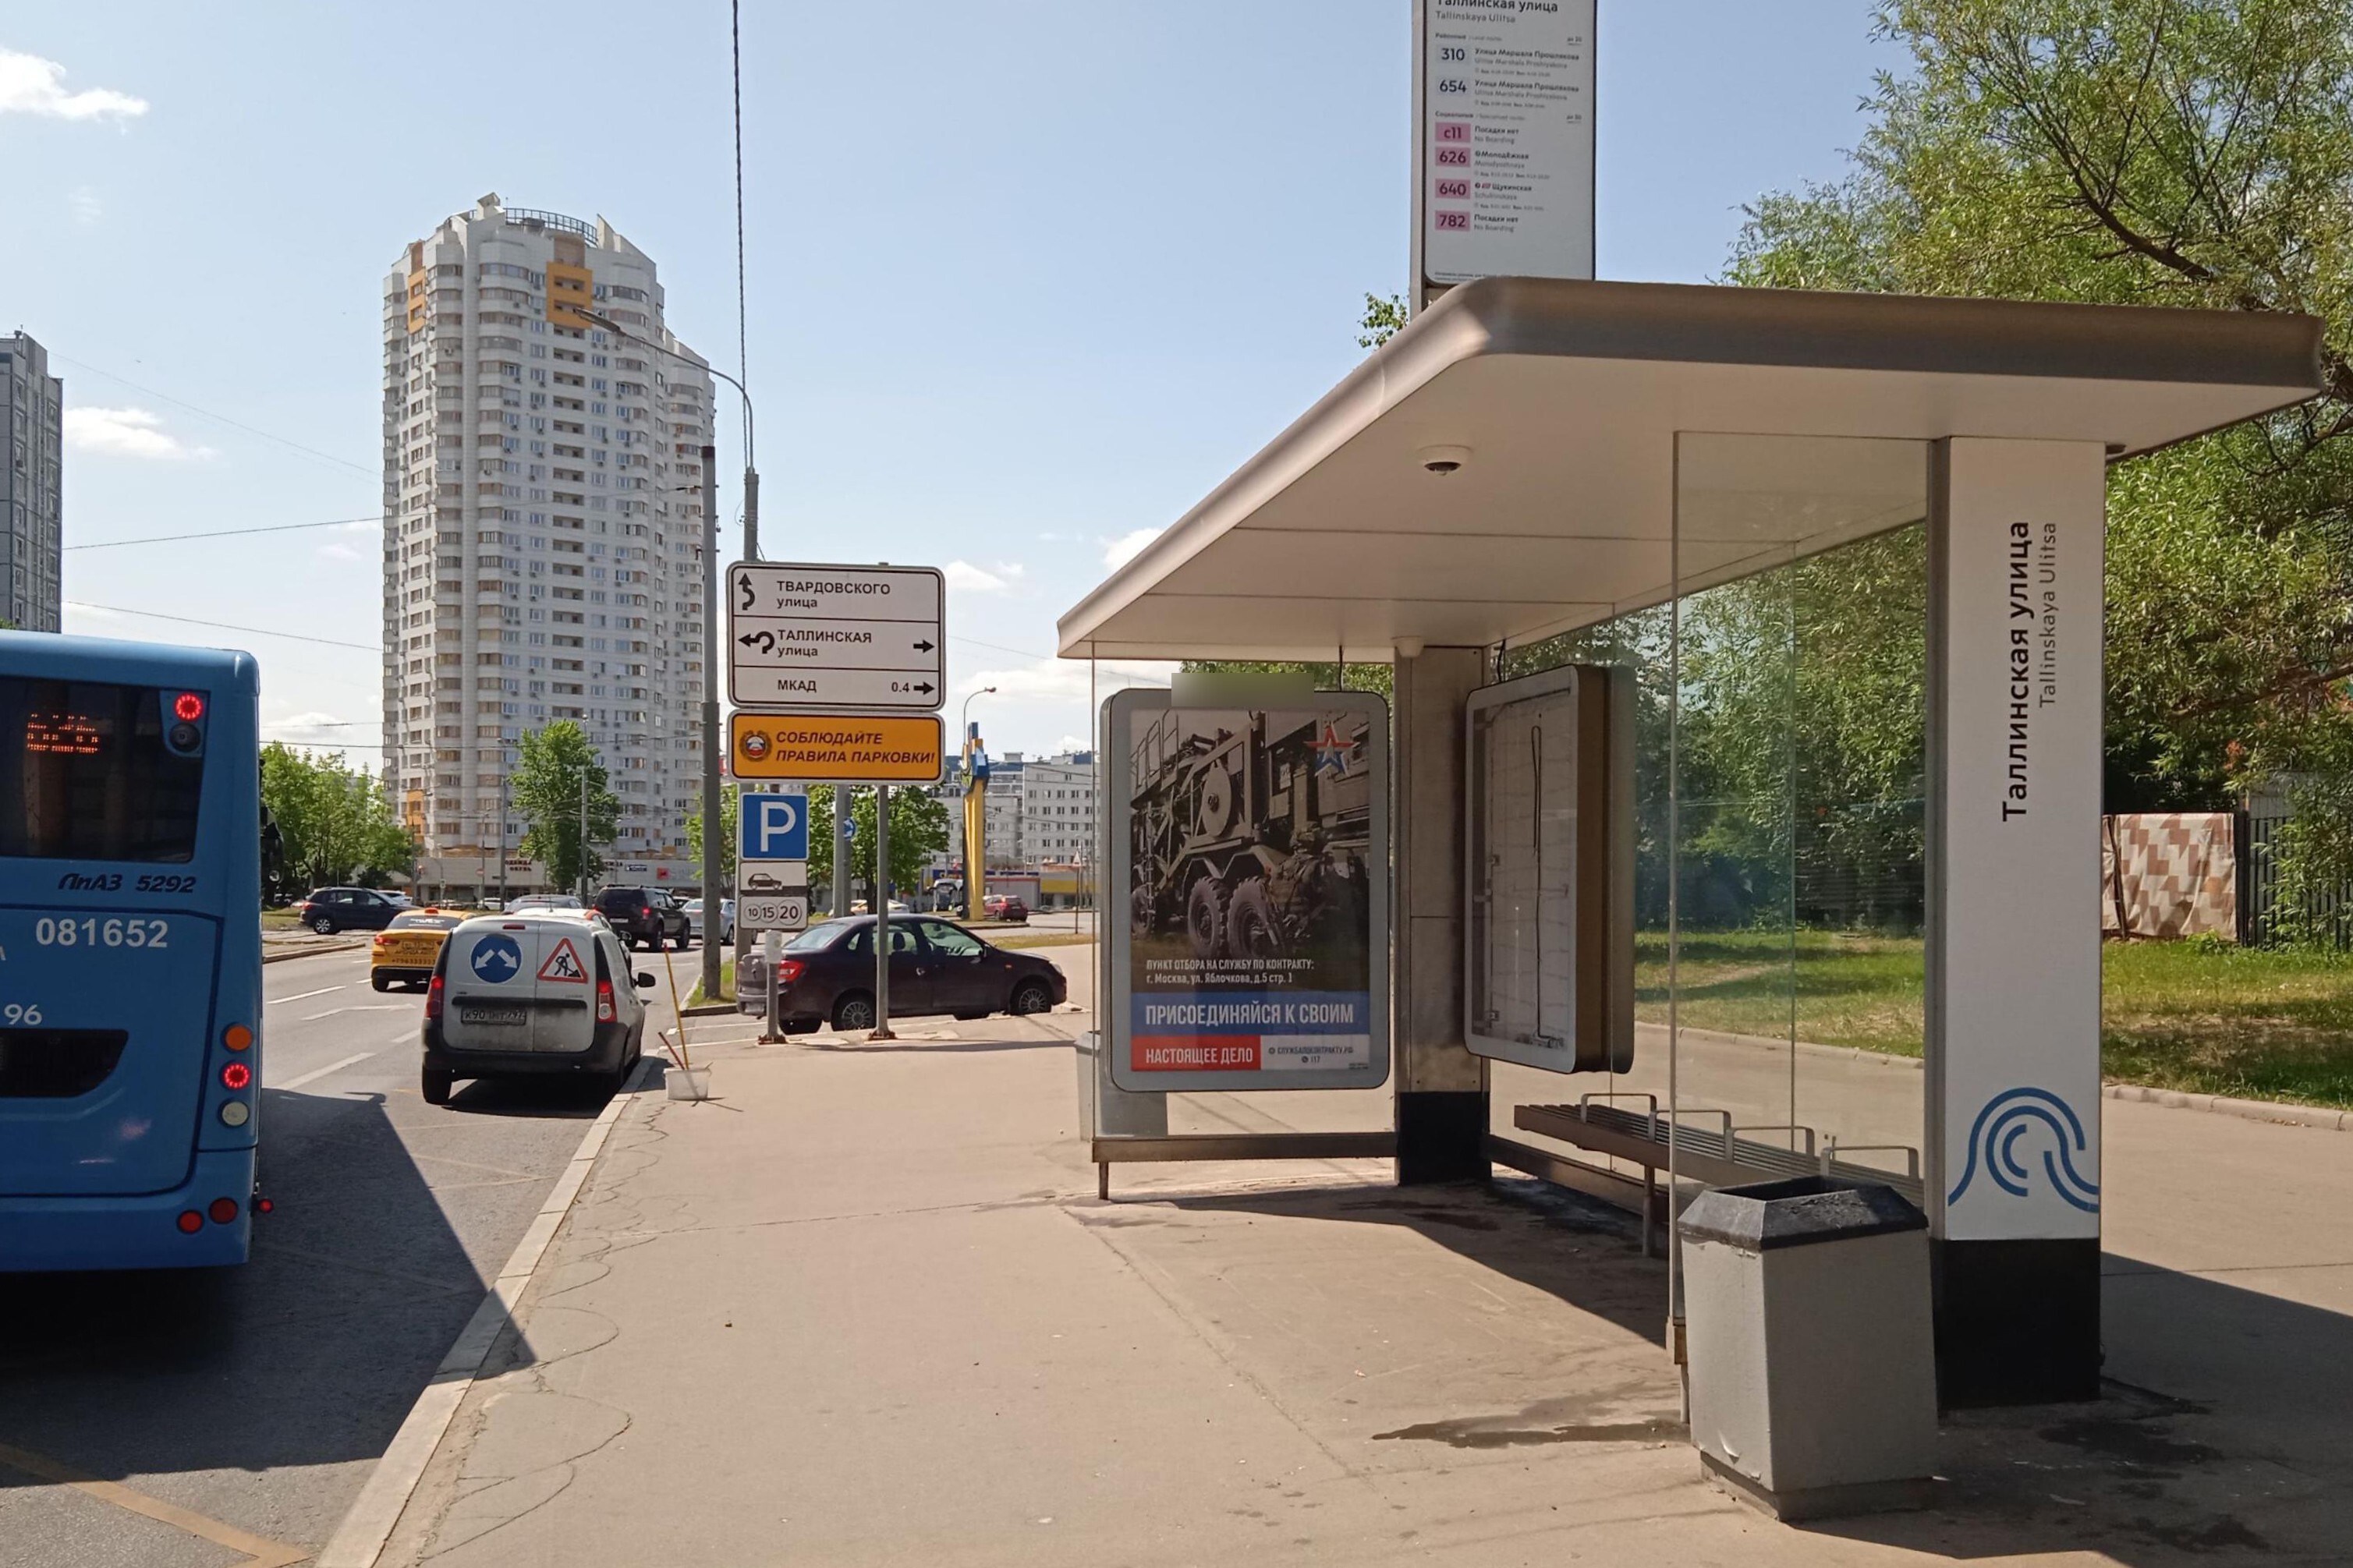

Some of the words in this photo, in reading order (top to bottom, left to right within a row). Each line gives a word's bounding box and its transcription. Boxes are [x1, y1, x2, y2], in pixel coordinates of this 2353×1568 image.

[1519, 2, 1558, 12] улица
[1436, 11, 1487, 22] Tallinskaya
[1489, 13, 1516, 23] Ulitsa
[1441, 48, 1465, 61] 310
[1439, 80, 1467, 93] 654
[1475, 126, 1505, 136] Посадки
[1439, 151, 1467, 164] 626
[1439, 182, 1467, 196] 640
[1439, 214, 1466, 228] 782
[1475, 214, 1505, 224] Посадки
[2039, 522, 2057, 584] Ulitsa
[2010, 522, 2034, 619] улица
[777, 580, 891, 595] ТВАРДОВСКОГО
[777, 597, 817, 609] улица
[778, 629, 872, 643] ТАЛЛИНСКАЯ
[778, 646, 818, 657] улица
[2039, 591, 2059, 708] Tallinskaya
[778, 679, 817, 693] МКАД
[891, 682, 909, 693] 0.4
[2003, 628, 2030, 822] Таллинская
[776, 731, 883, 746] СОБЛЮДАЙТЕ
[776, 750, 847, 763] ПРАВИЛА
[851, 751, 934, 764] ПАРКОВКИ!
[760, 802, 796, 852] P
[135, 876, 196, 894] 5292
[749, 908, 758, 919] 10
[763, 907, 774, 919] 15
[780, 906, 799, 919] 20
[36, 918, 168, 948] 081652
[1146, 960, 1172, 970] ПУНКТ
[1175, 960, 1206, 970] ОТБОРА
[1207, 960, 1218, 970] НА
[1219, 959, 1252, 970] СЛУЖБУ
[1253, 959, 1264, 969] ПО
[1266, 959, 1314, 969] КОНТРАКТУ:
[1154, 974, 1189, 985] Москва,
[1146, 1001, 1281, 1026] ПРИСОЕДИНЯЙСЯ
[1285, 1004, 1295, 1024] К
[1299, 1003, 1353, 1024] СВОИМ
[1146, 1048, 1217, 1065] НАСТОЯЩЕЕ
[1221, 1047, 1253, 1064] ДЕЛО
